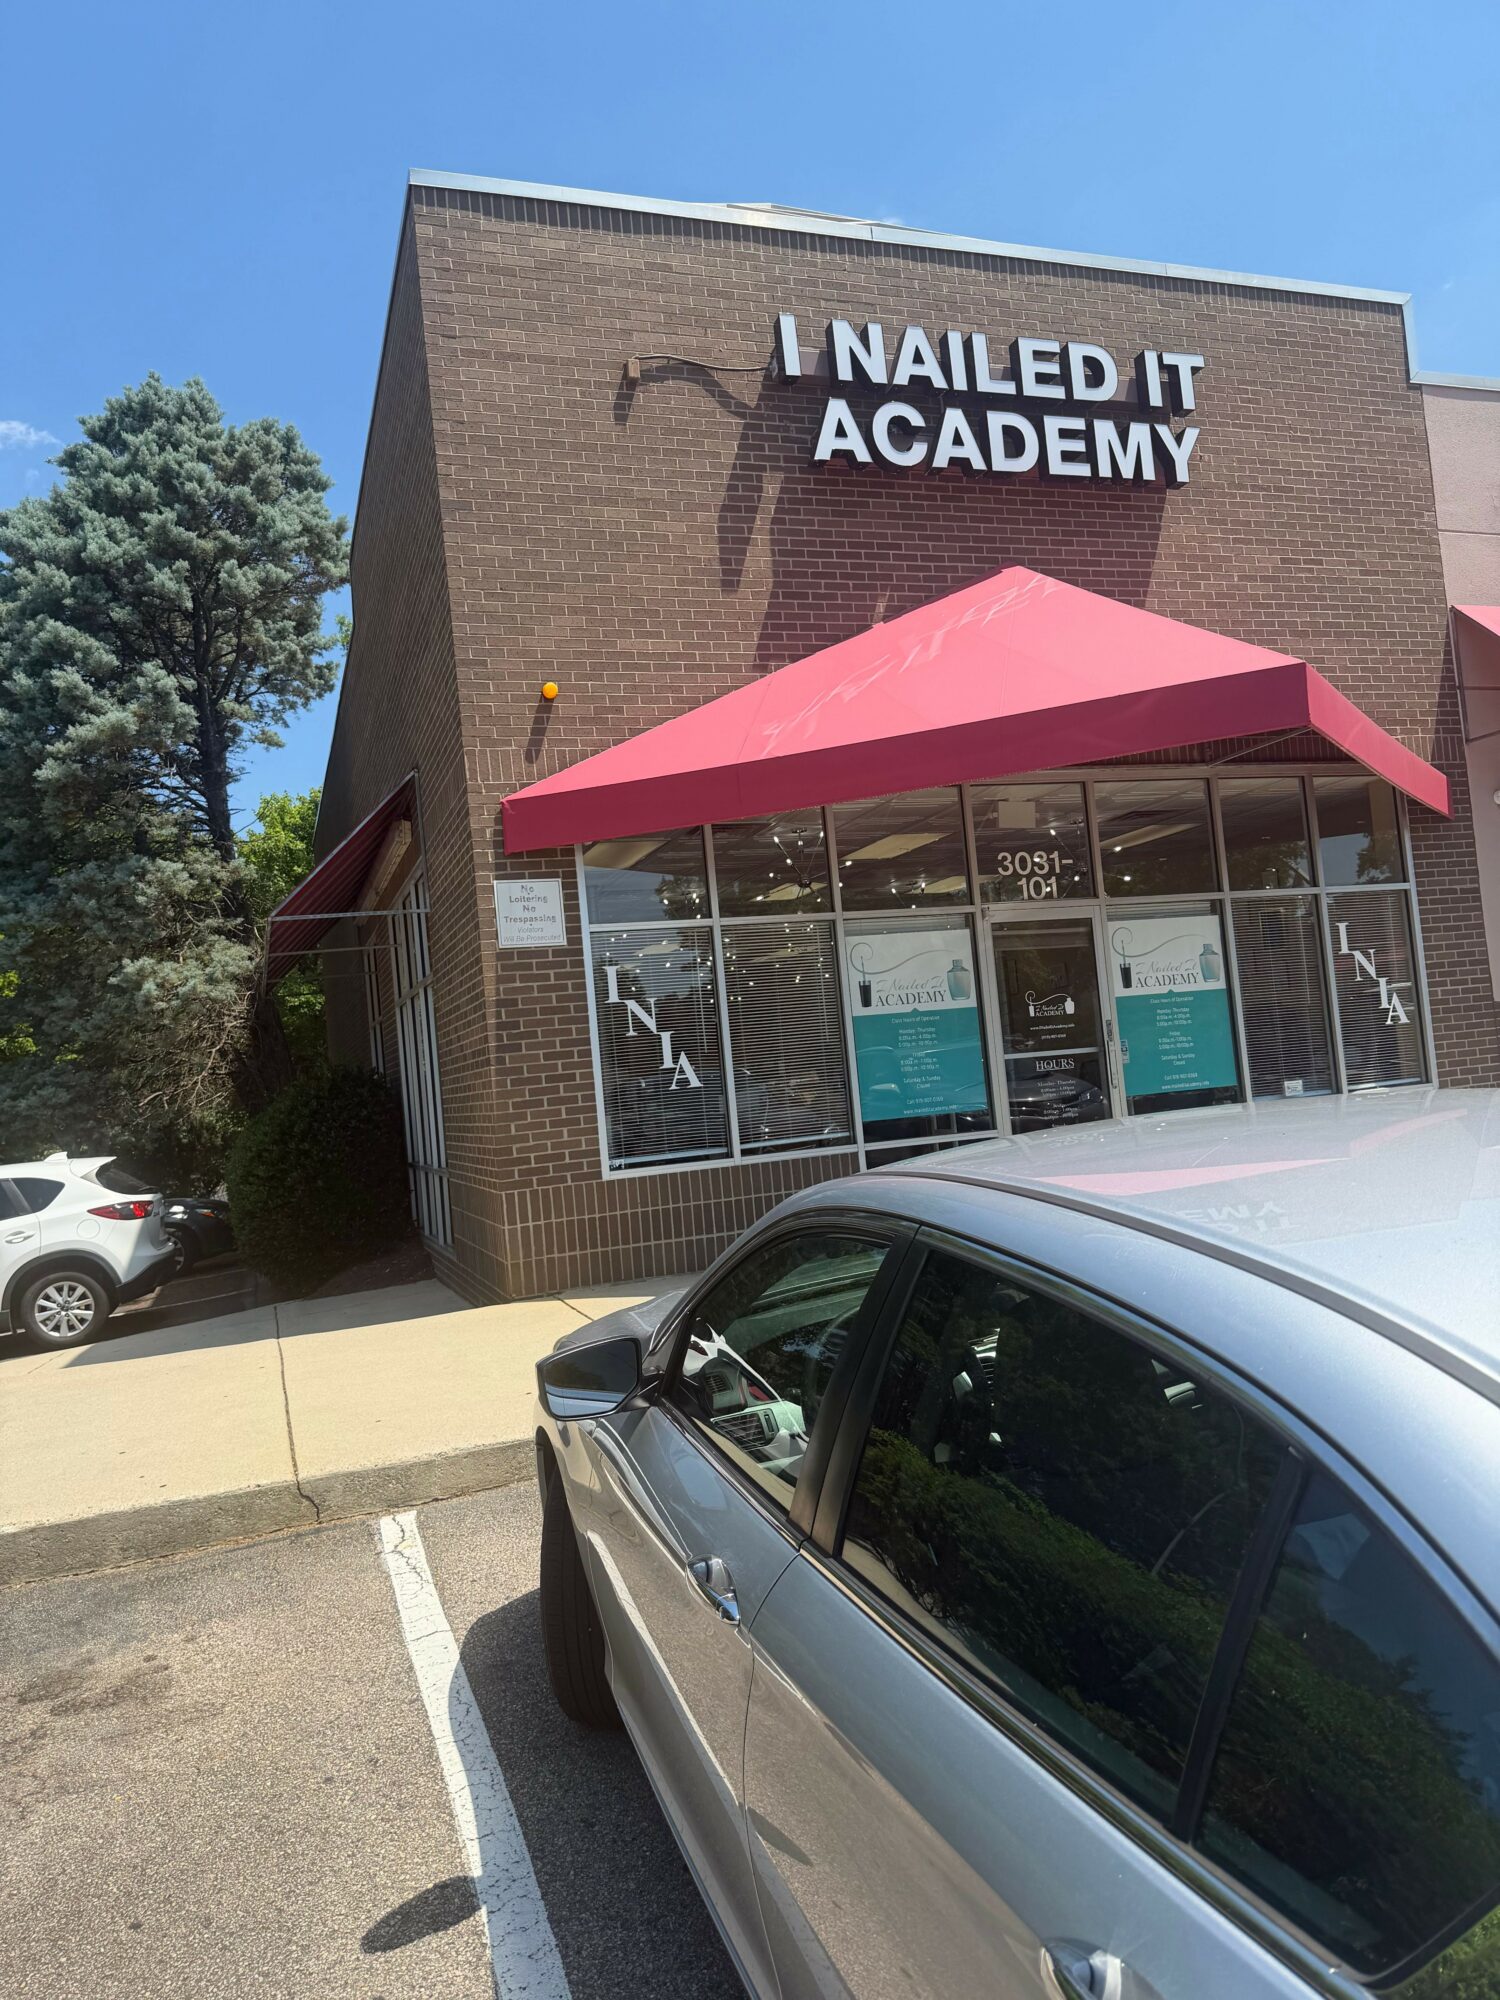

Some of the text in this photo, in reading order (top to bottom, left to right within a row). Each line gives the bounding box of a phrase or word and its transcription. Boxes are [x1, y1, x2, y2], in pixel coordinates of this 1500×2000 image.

[777, 313, 1206, 412] I NAILED IT
[814, 397, 1201, 484] ACADEMY
[520, 884, 535, 894] No
[1016, 876, 1059, 900] 101
[509, 894, 549, 904] Loitering
[522, 904, 537, 913] No
[504, 914, 557, 924] Trespassing
[526, 934, 562, 942] Prosecuted
[1135, 972, 1199, 989] ACADEMY
[875, 990, 947, 1007] ACADEMY
[1035, 1009, 1065, 1017] ACADEMY
[1035, 1058, 1076, 1071] HOURS
